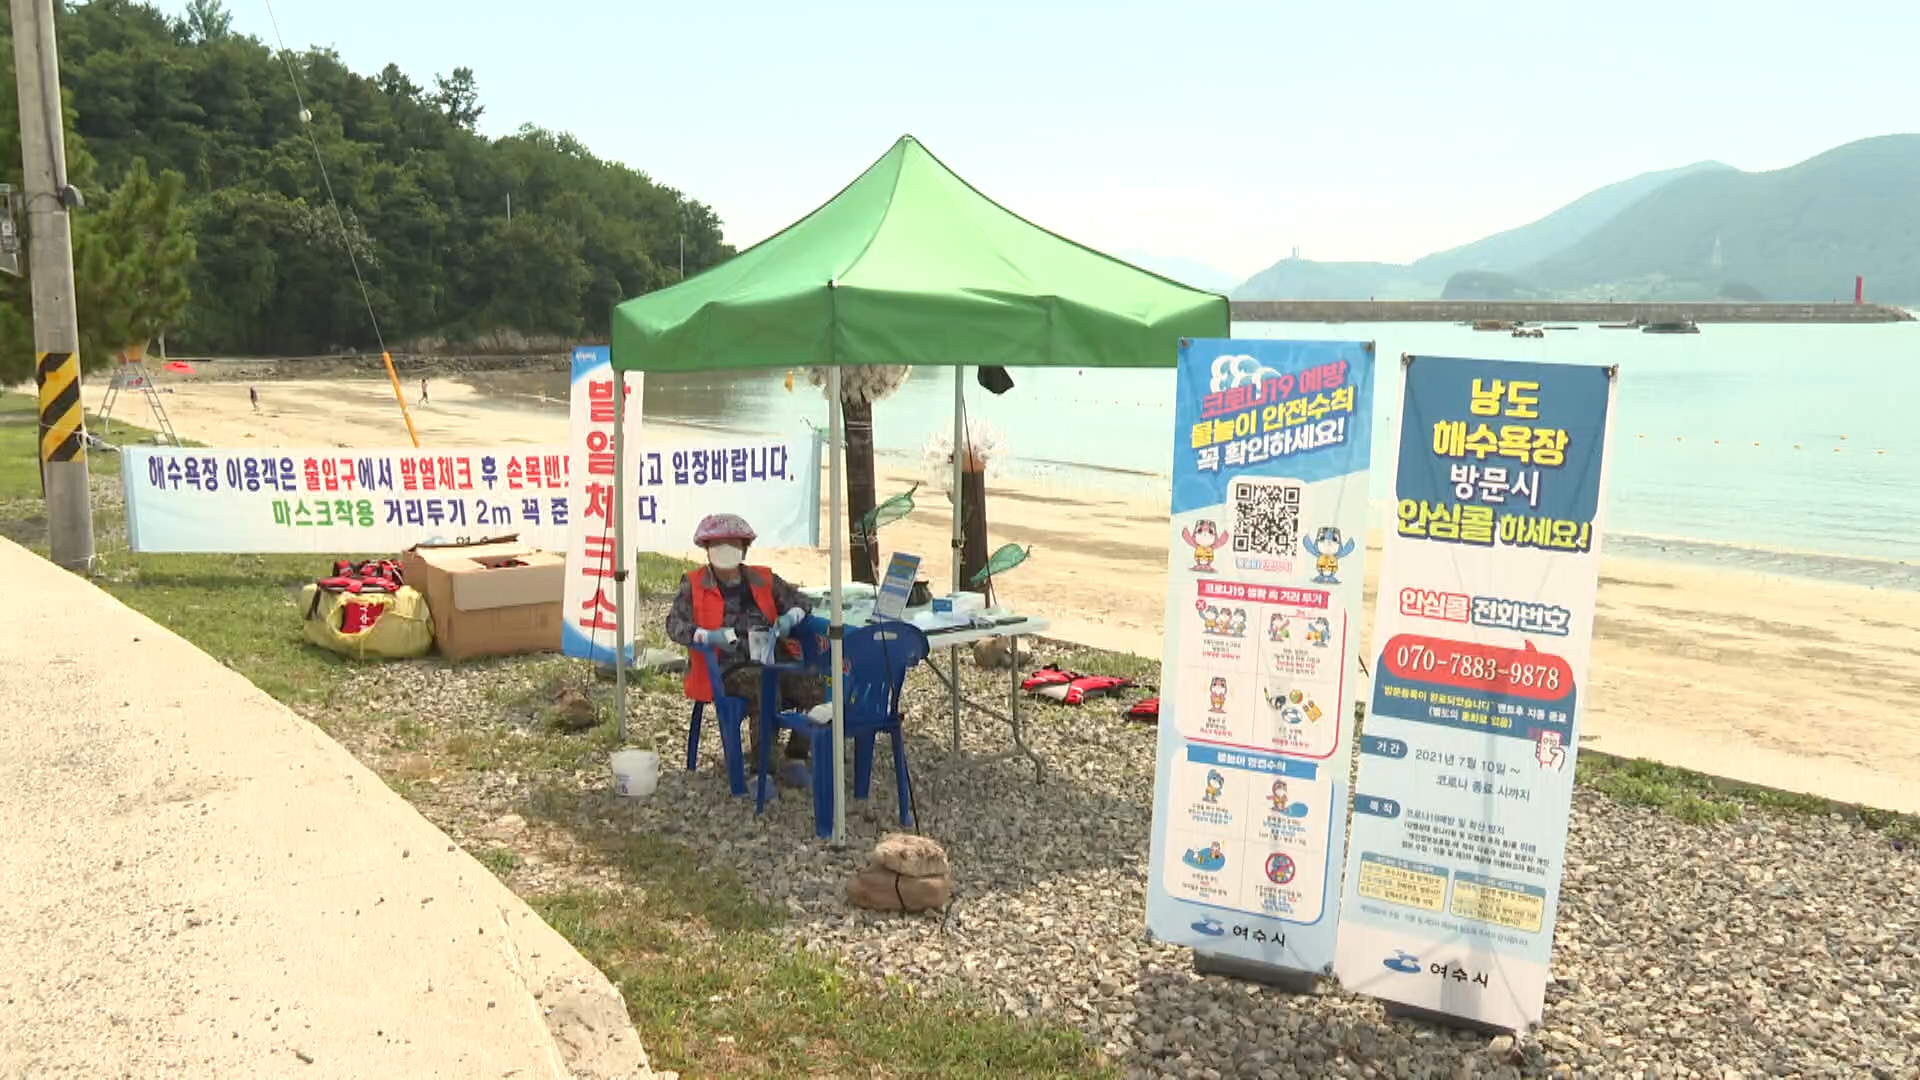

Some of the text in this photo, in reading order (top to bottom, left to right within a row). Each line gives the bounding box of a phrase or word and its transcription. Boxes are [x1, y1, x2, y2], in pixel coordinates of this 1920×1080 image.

[1202, 360, 1347, 418] 코로나19 예방
[1191, 386, 1354, 448] 물놀이 안전수칙
[1198, 418, 1345, 471] 꼭 확인하세요!
[1432, 420, 1569, 466] 해수욕장
[148, 456, 218, 491] 해수욕장
[226, 456, 296, 491] 이용객은
[303, 456, 393, 491] 출입구에서
[400, 456, 473, 490] 발열체크
[481, 455, 498, 490] 후
[672, 445, 794, 485] 입장바랍니다.
[1450, 464, 1540, 506] 방문시
[272, 499, 375, 528] 마스크착용
[383, 499, 466, 526] 거리두기
[476, 499, 511, 525] 2m
[522, 498, 540, 525] 꼭
[1397, 499, 1592, 550] 안심콜 하세요!
[1400, 587, 1571, 636] 안심콜 전화번호
[1396, 645, 1560, 690] 070-7883-9878
[1415, 749, 1454, 766] 2021년
[1459, 757, 1477, 770] 7월
[1482, 761, 1506, 776] 10일
[1498, 785, 1530, 802] 시까지
[1233, 925, 1286, 947] 여수시
[1430, 962, 1489, 989] 여수시
